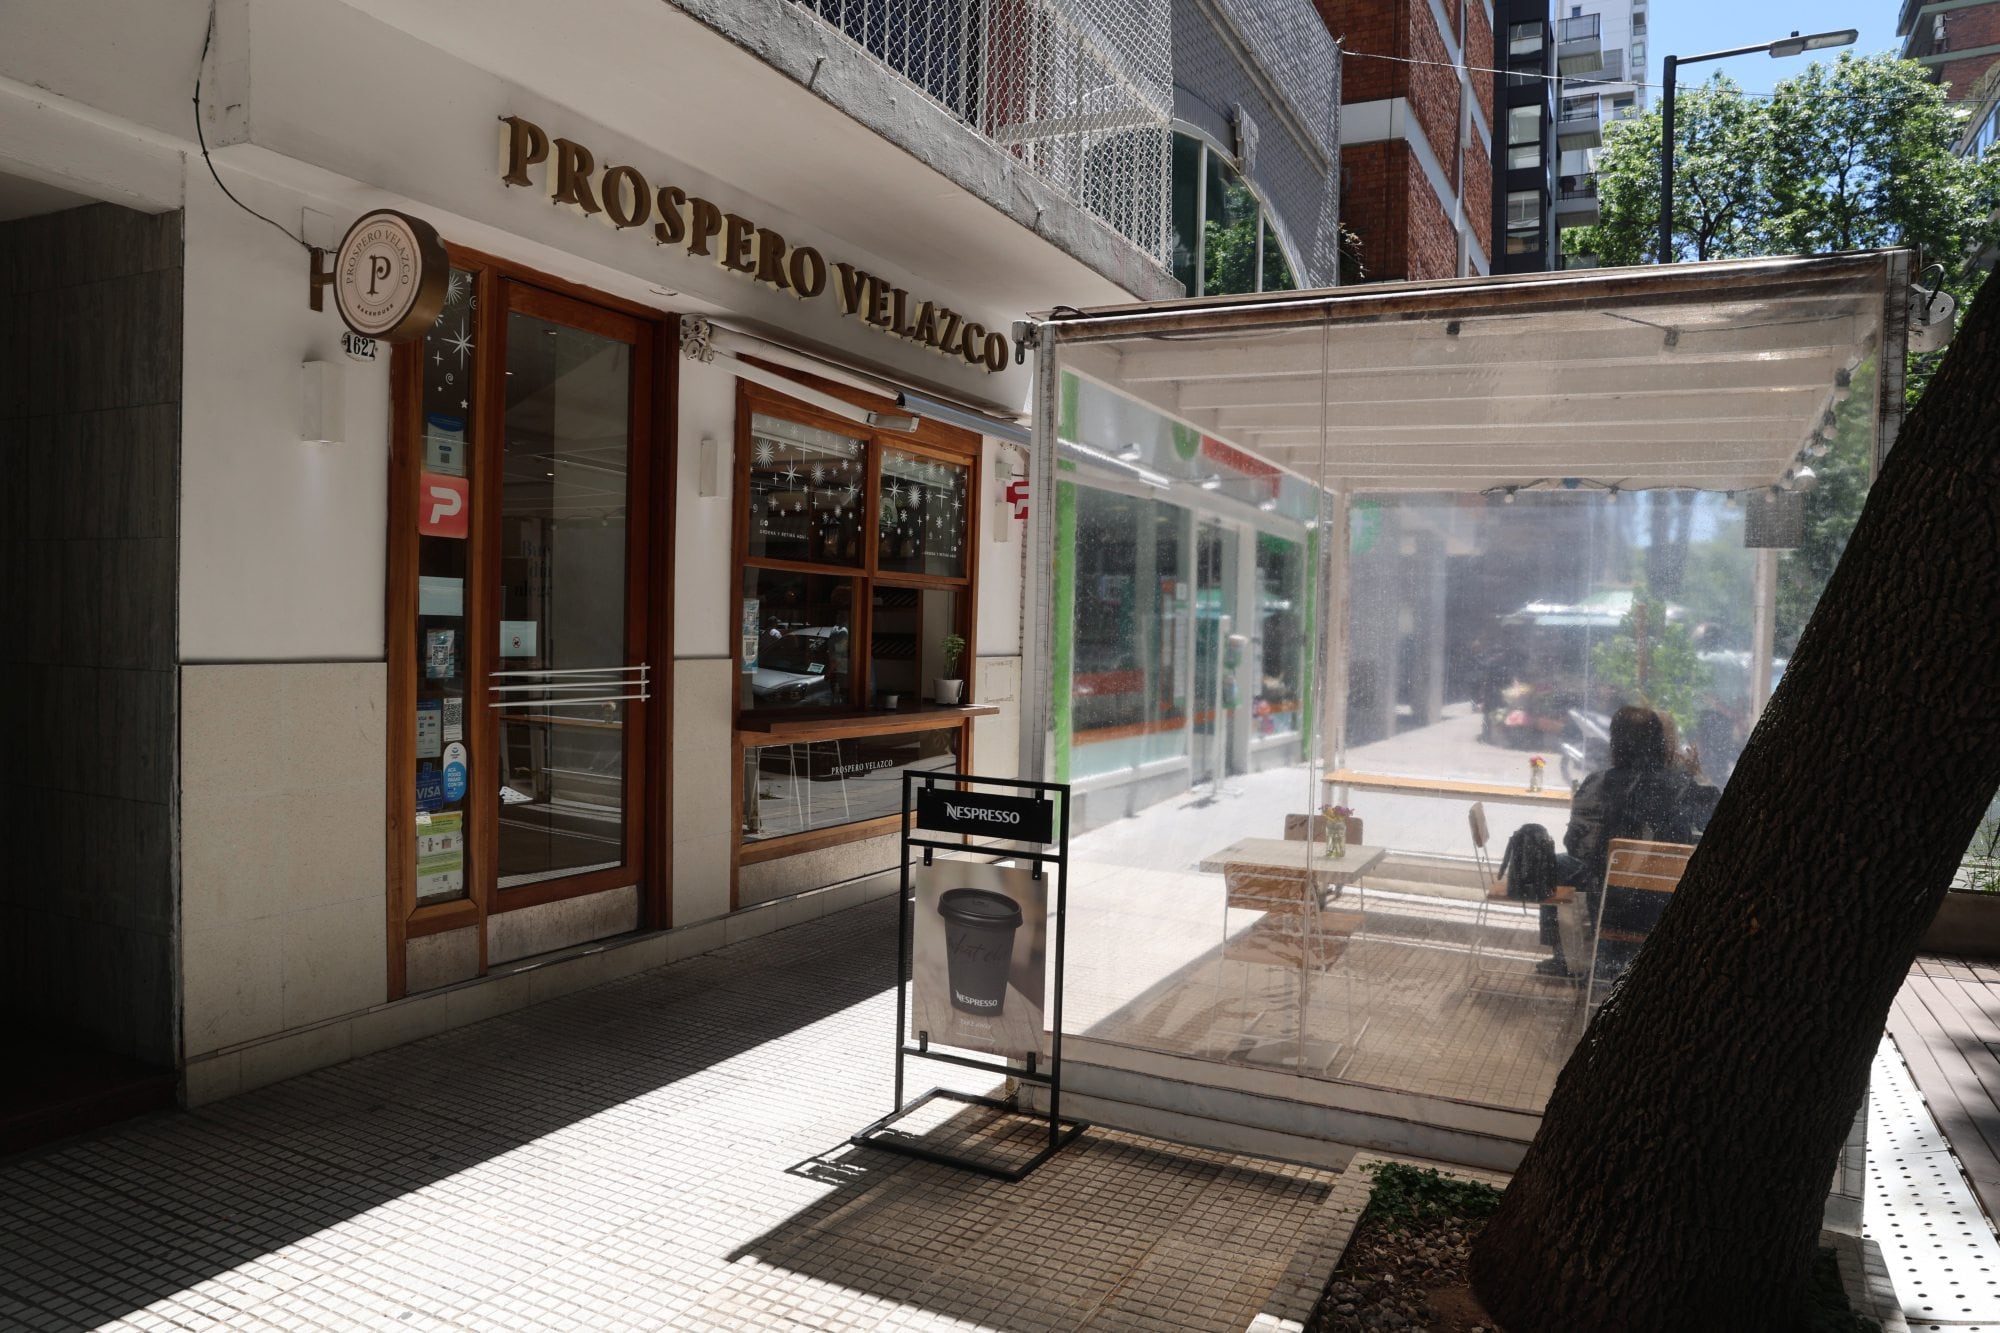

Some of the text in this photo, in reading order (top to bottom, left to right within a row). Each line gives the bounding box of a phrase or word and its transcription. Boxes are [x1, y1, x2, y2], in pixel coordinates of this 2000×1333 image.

[499, 114, 1010, 373] PROSPERO VELAZCO
[346, 229, 411, 285] PROSPERO VELAZCO
[345, 335, 376, 358] 1627
[831, 759, 893, 775] PROSPERO VELAZCO
[416, 785, 441, 800] VISA
[945, 802, 1020, 825] NESPRESSO
[955, 989, 998, 1007] NESPRESSO
